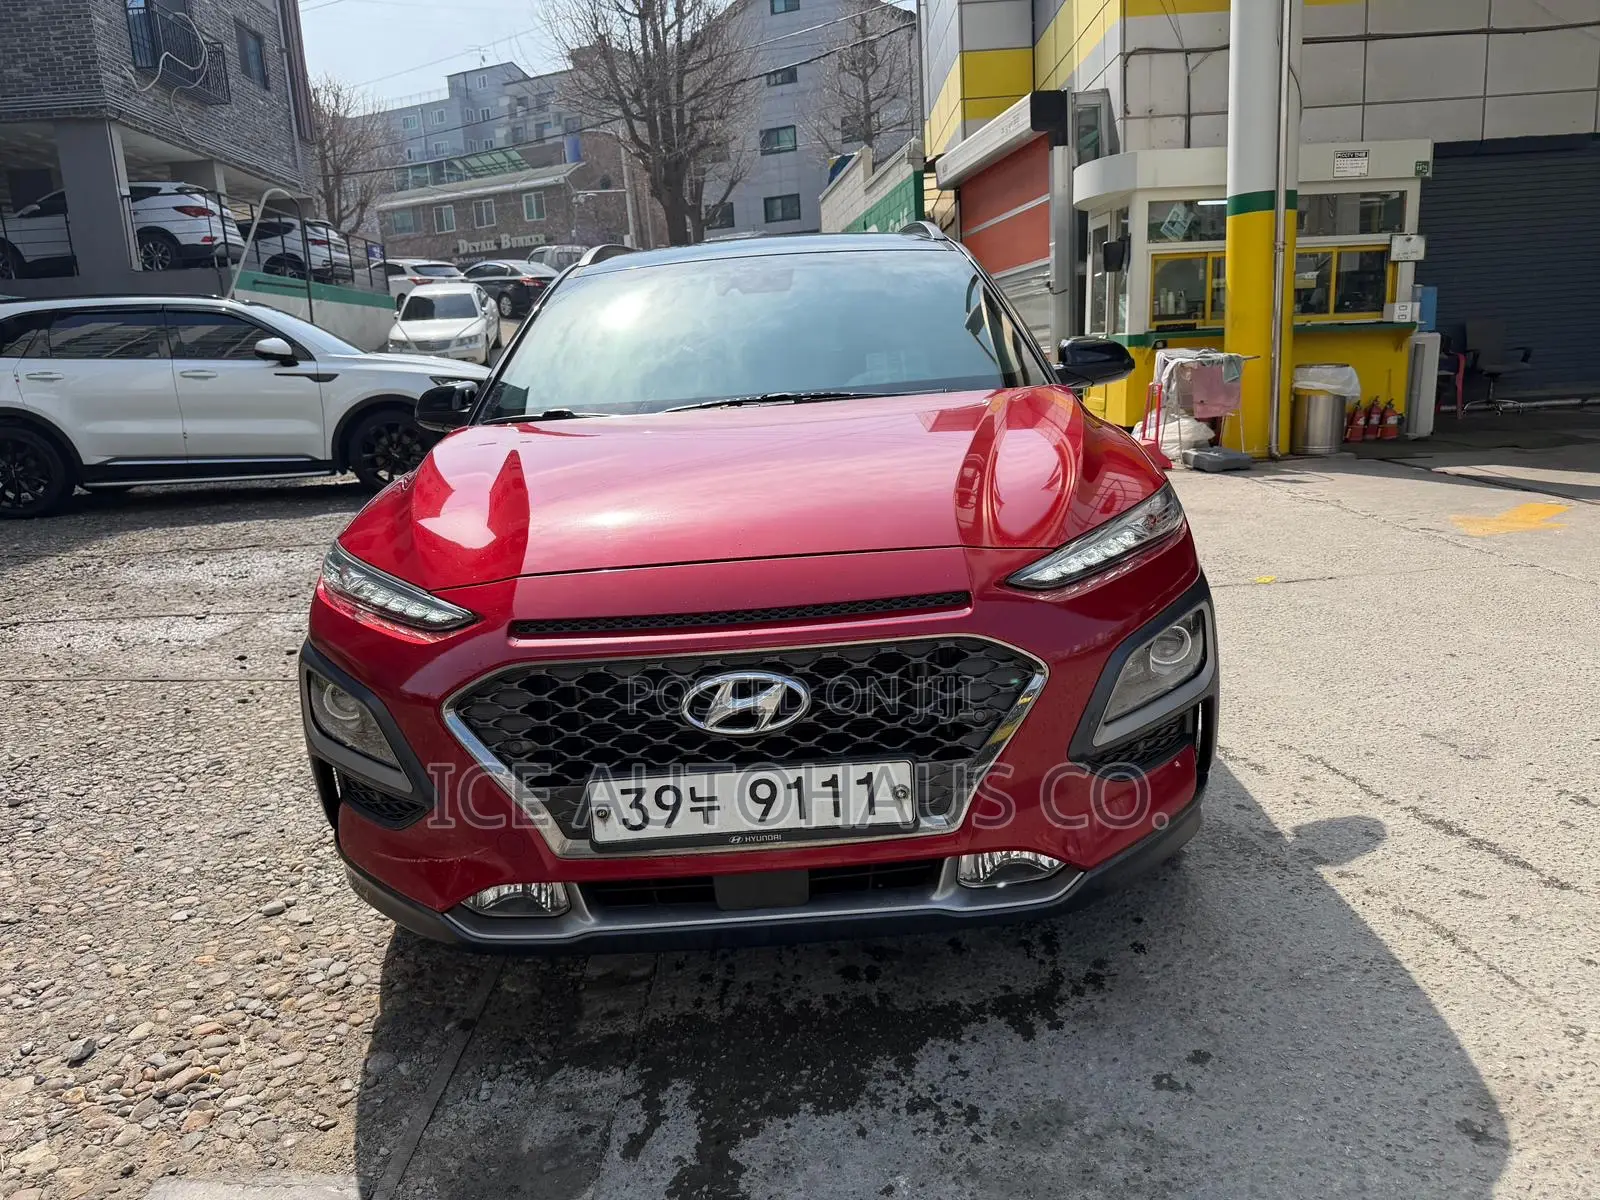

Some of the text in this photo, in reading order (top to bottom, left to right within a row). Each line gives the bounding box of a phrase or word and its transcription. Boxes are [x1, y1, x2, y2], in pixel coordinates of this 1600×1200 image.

[458, 233, 546, 254] DETAIL BUNKER
[620, 772, 876, 831] 39누 9111
[745, 834, 782, 843] HYUNDAI
